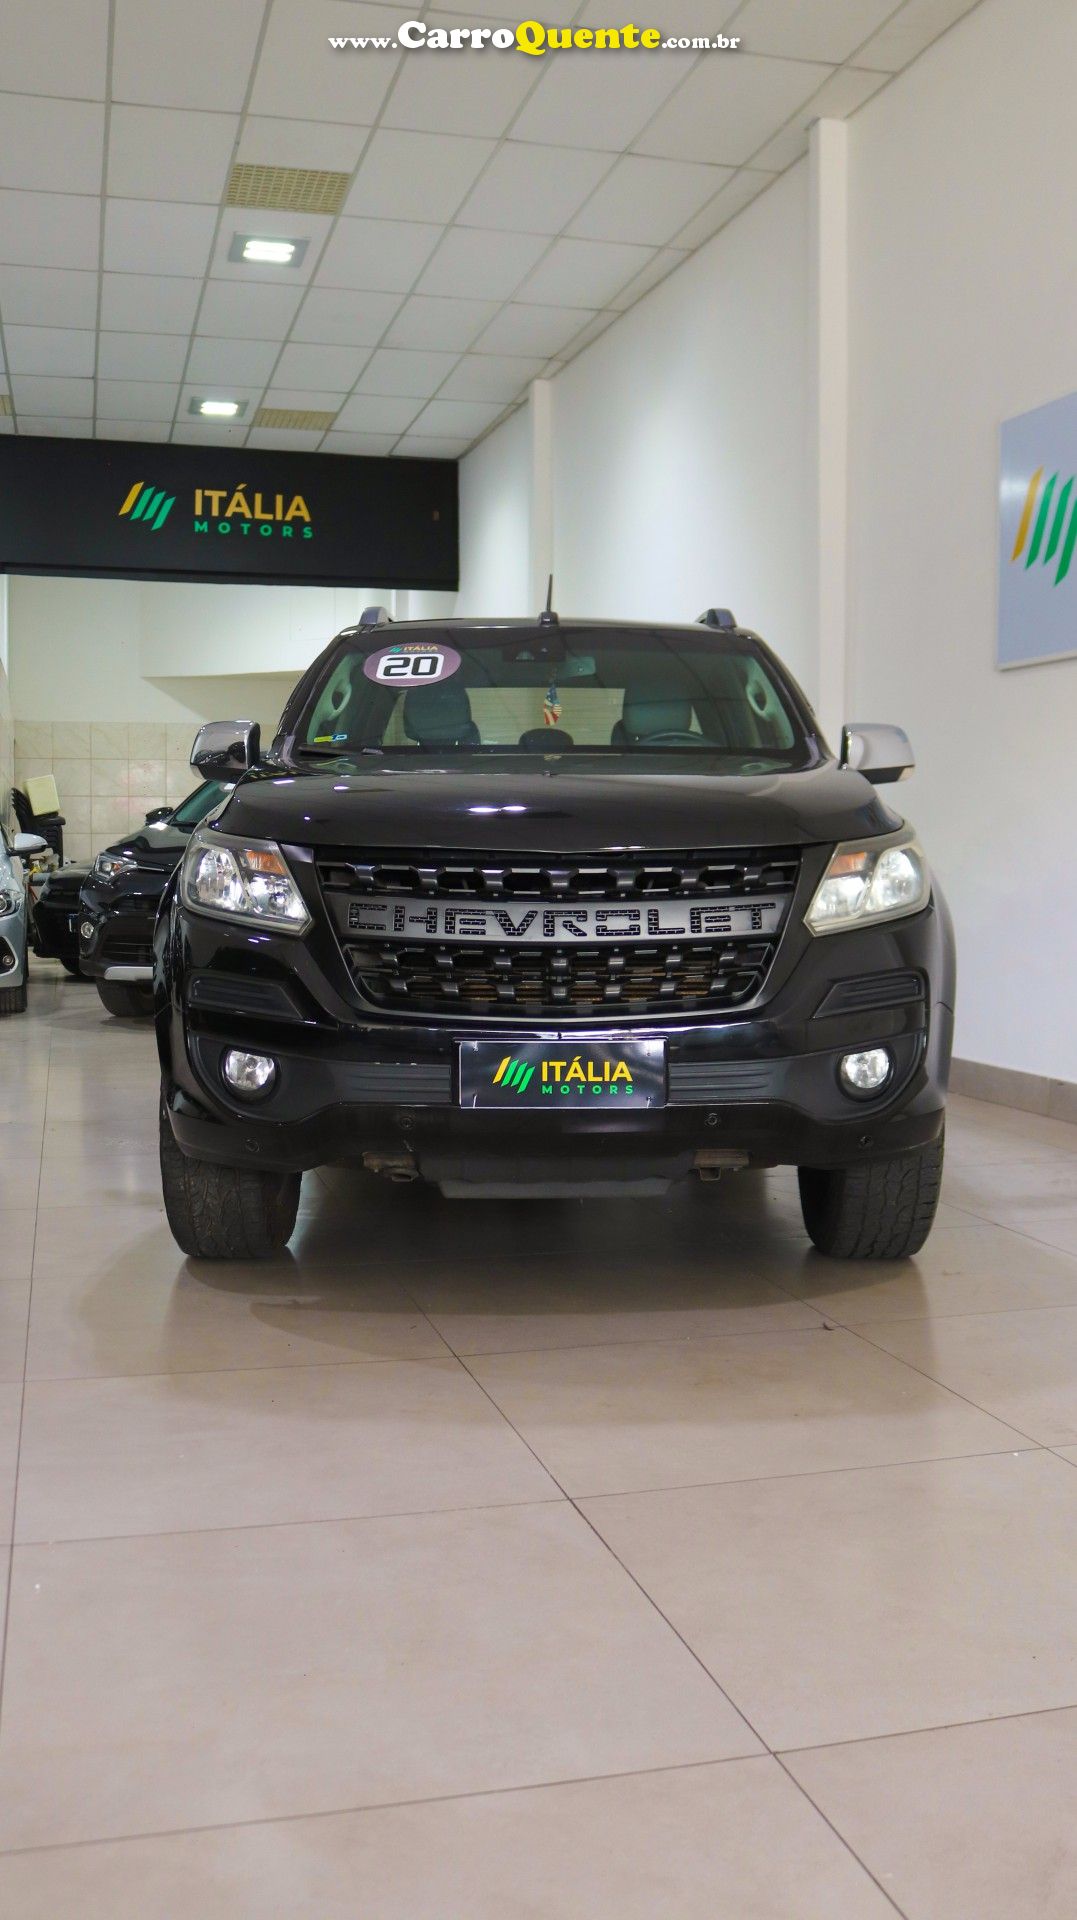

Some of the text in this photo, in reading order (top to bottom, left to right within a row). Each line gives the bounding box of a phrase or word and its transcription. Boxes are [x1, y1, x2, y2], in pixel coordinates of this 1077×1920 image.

[194, 484, 312, 522] ITÁLIA
[194, 521, 313, 539] MOTORS
[383, 657, 438, 676] 20
[349, 902, 776, 936] CHEVROLET
[541, 1056, 633, 1082] ITÁLIA
[541, 1085, 634, 1096] MOTORS
